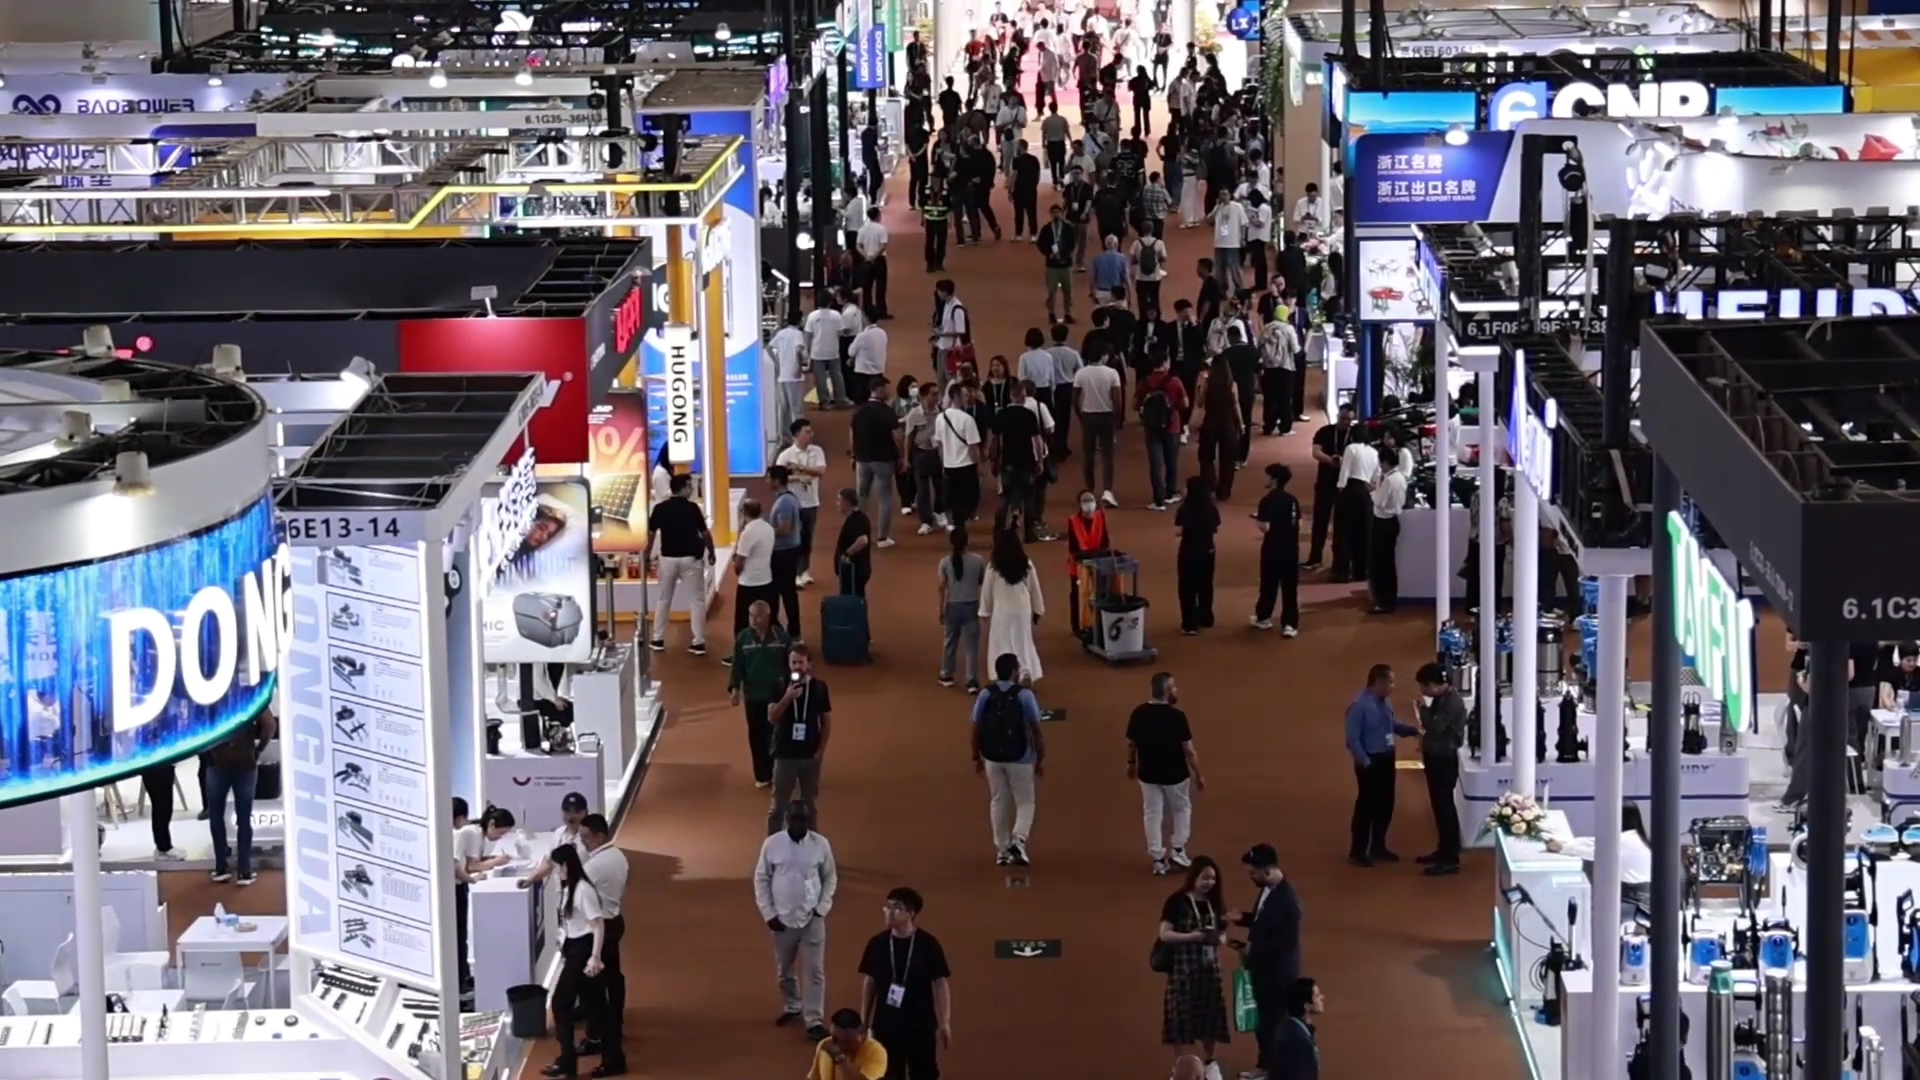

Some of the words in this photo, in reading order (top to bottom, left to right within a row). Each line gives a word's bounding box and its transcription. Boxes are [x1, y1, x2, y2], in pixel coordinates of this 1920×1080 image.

[1377, 154, 1443, 170] 浙江名牌
[1377, 179, 1477, 196] 浙江出口名牌
[671, 346, 688, 444] HUGONG
[111, 542, 295, 733] DONG
